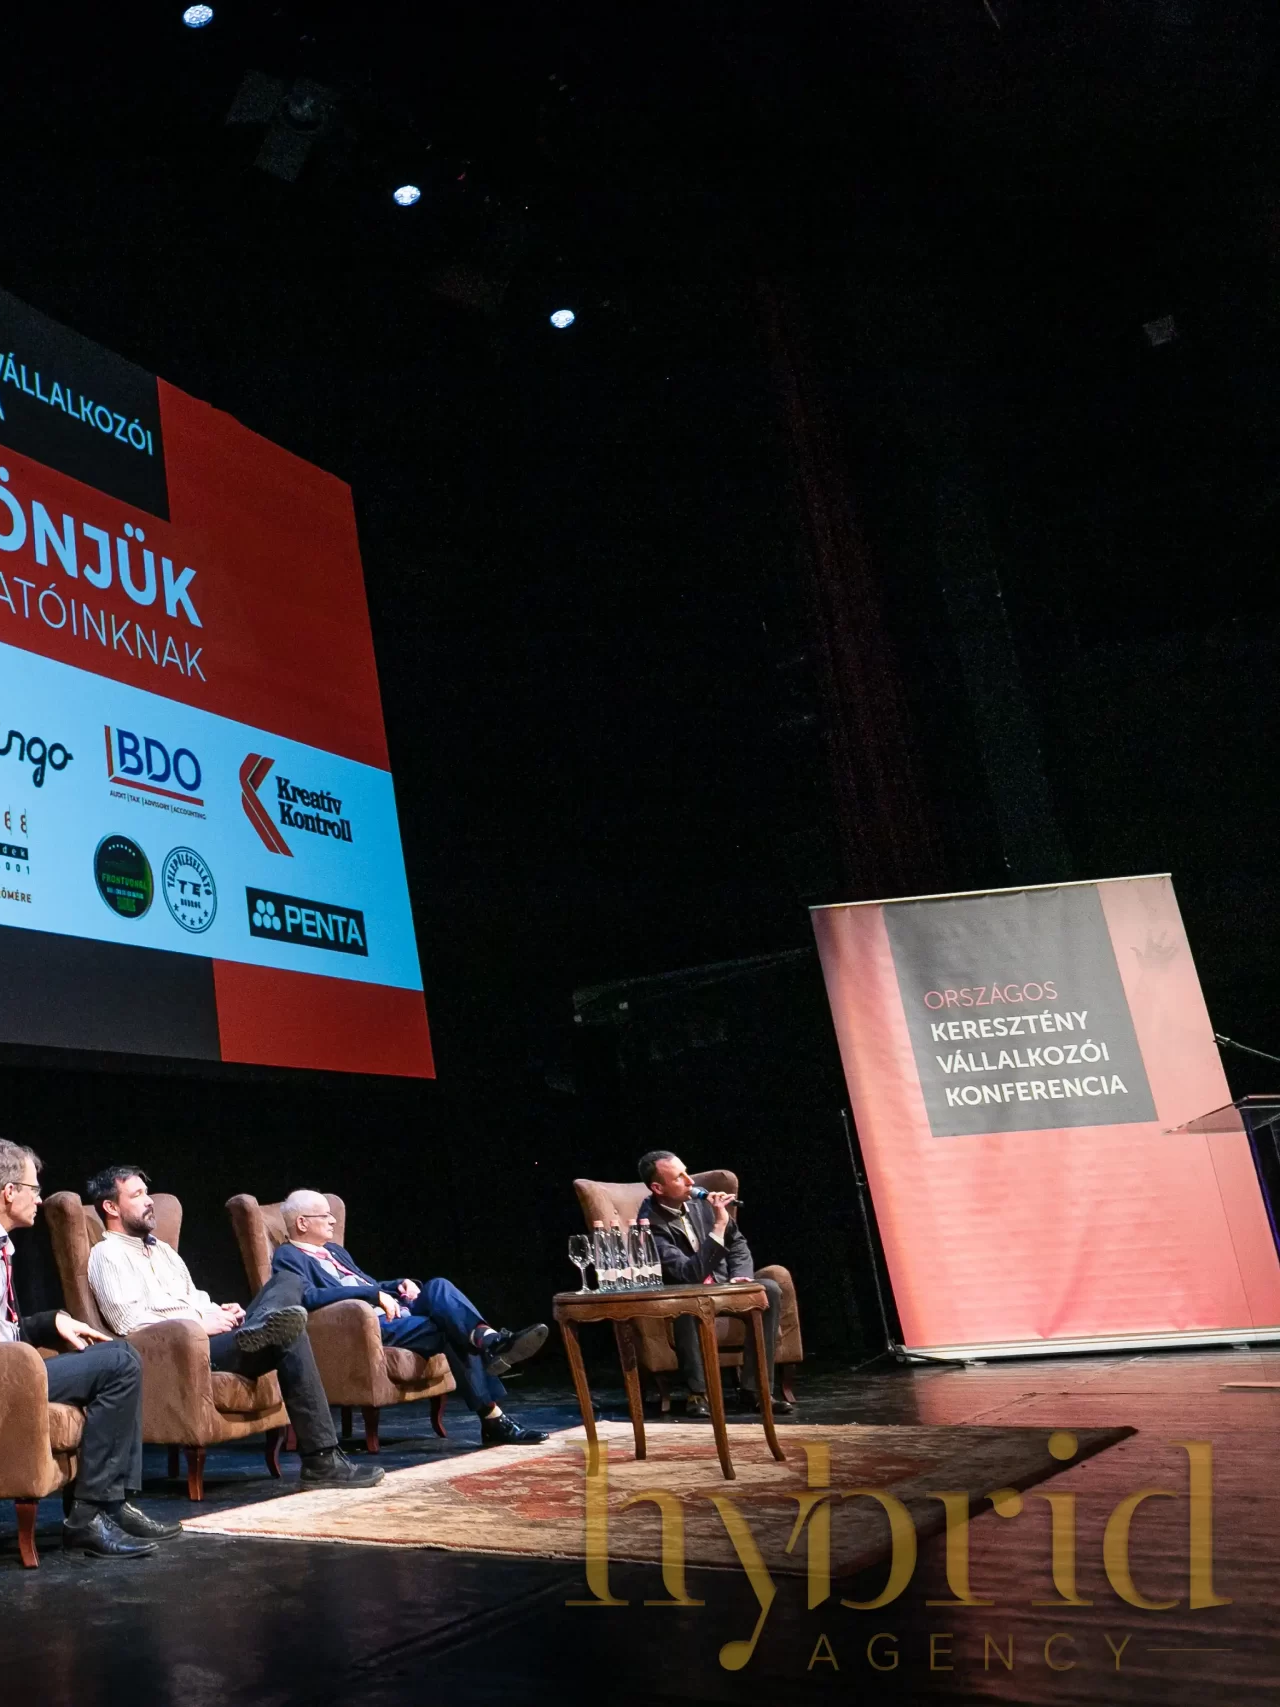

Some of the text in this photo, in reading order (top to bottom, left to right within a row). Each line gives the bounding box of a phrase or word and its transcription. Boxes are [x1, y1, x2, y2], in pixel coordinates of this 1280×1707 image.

[116, 727, 202, 792] BDO
[275, 775, 342, 816] Kreatív
[278, 801, 353, 843] Kontroll
[284, 904, 364, 947] PENTA
[923, 981, 1058, 1010] ORSZÁGOS
[930, 1010, 1089, 1042] KERESZTÉNY
[936, 1040, 1110, 1074] VÁLLALKOZÓI
[945, 1074, 1128, 1107] KONFERENCIA
